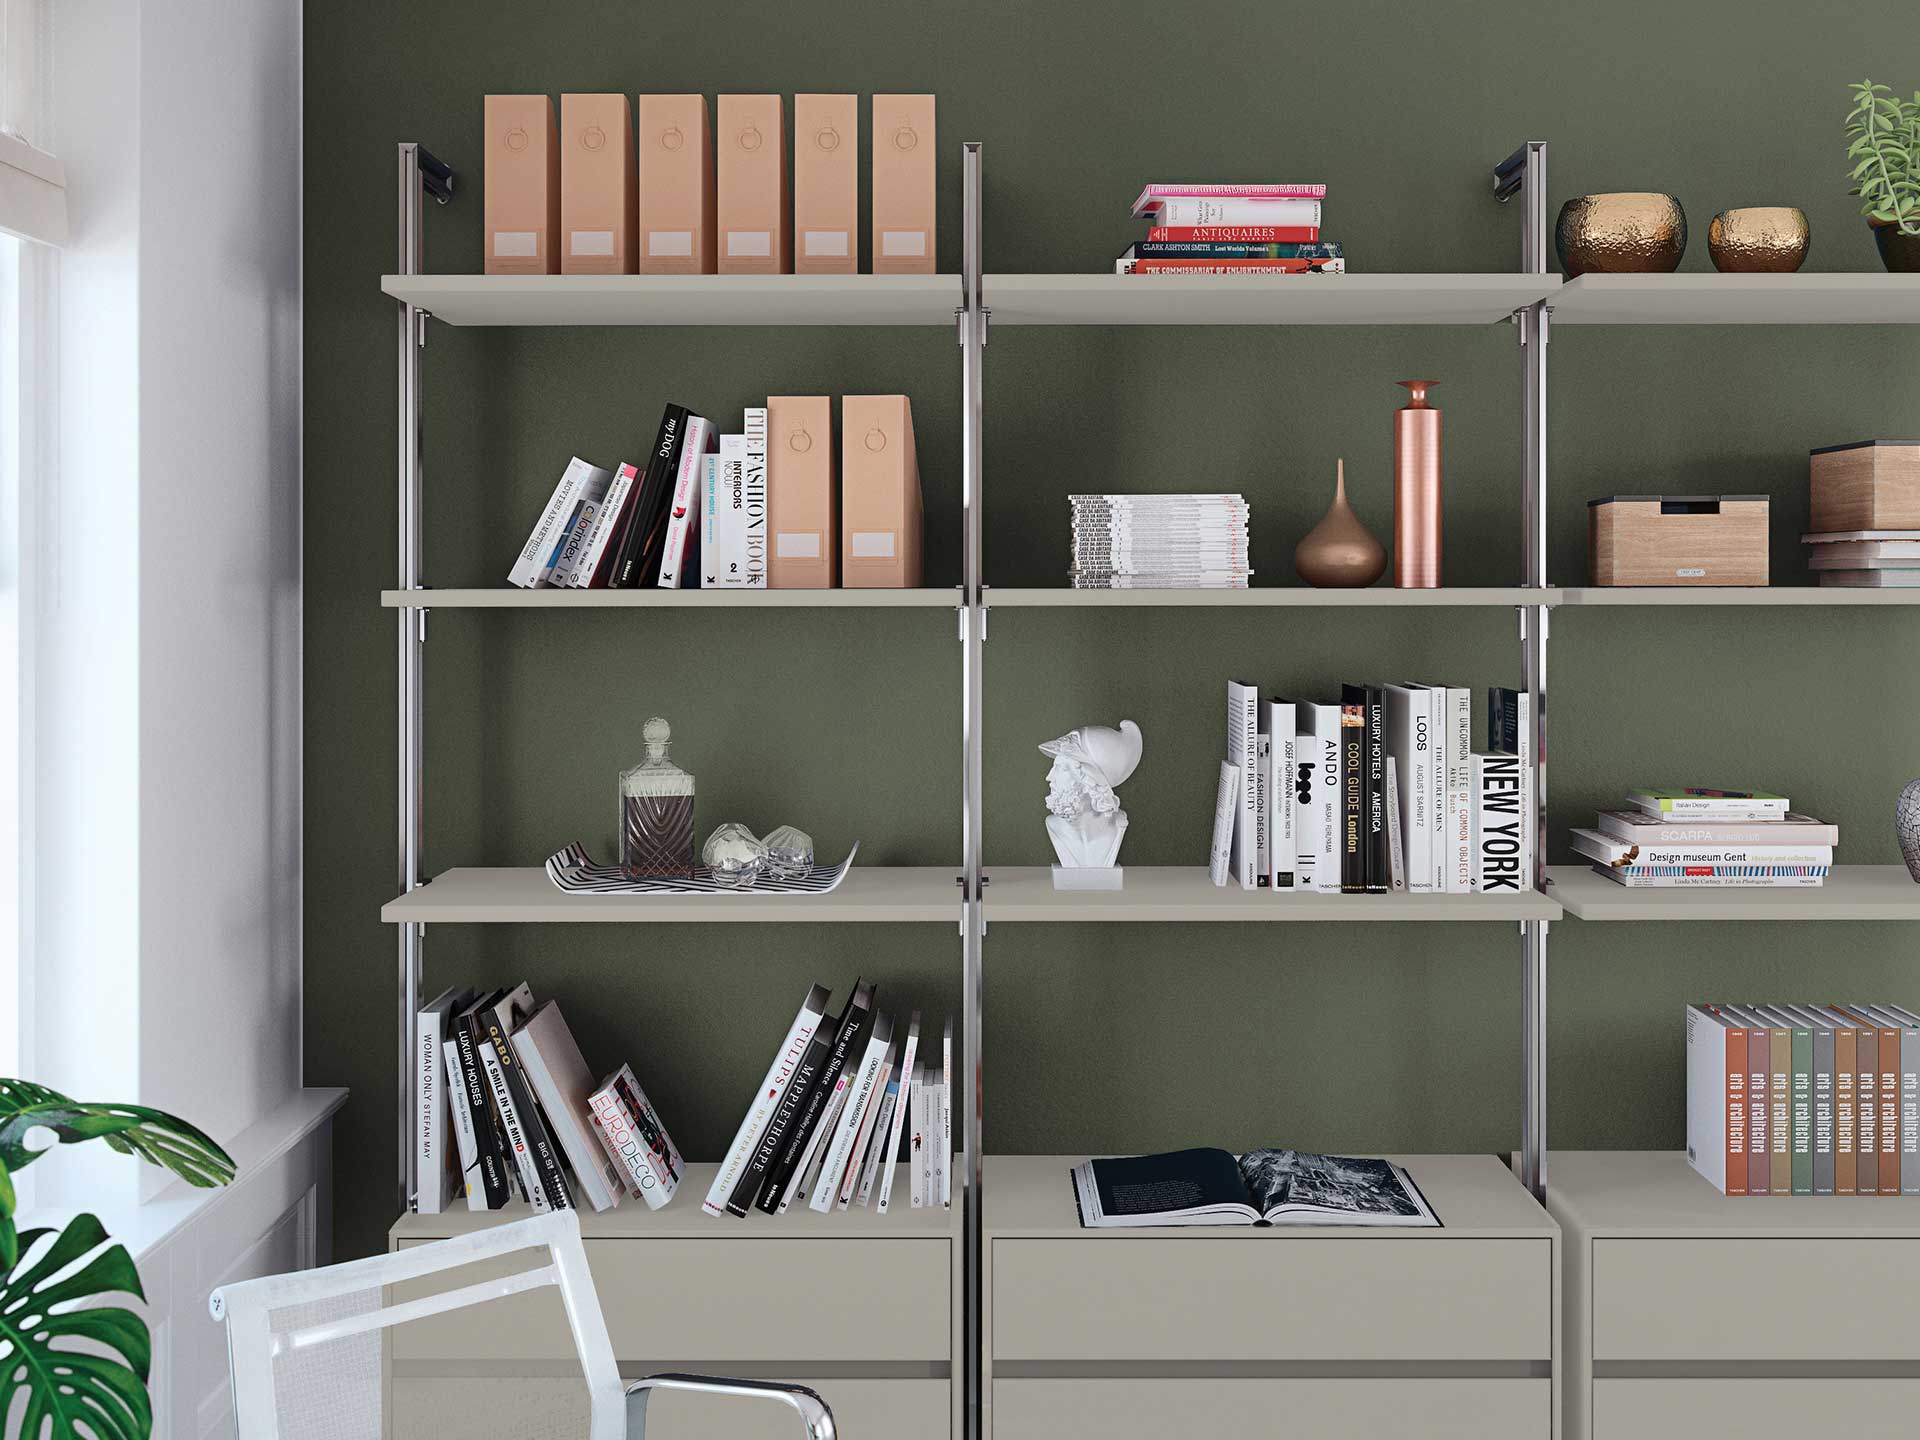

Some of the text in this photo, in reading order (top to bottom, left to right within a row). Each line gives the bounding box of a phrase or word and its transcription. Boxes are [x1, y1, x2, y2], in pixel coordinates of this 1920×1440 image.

[1142, 243, 1210, 251] CLARK ASHTON SMITH
[1192, 228, 1275, 239] ANTIQUAIRES
[1226, 266, 1286, 274] ENLIGHTENMENT
[658, 417, 676, 458] my DOG
[687, 424, 698, 446] History
[677, 479, 688, 501] Design
[724, 460, 732, 486] NOW!
[733, 460, 741, 508] INTERIORS
[553, 478, 573, 510] MOVIES
[746, 410, 764, 584] THE FASHION BOOK
[525, 525, 548, 561] METHODS
[562, 504, 598, 563] colorindex
[730, 563, 737, 573] 2
[1416, 715, 1427, 751] LOOS
[1246, 699, 1254, 810] THE ALLURE OF BEAUTY
[1284, 740, 1292, 798] JOSEF HOFFMANN
[1324, 740, 1336, 786] ANDO
[1371, 704, 1380, 832] LUXURY HOTELS AMERICA
[1347, 742, 1358, 852] COOL GUIDE London
[1416, 764, 1424, 826] AUGUST SARNITZ
[1434, 745, 1442, 832] THE ALLURE OF MEN
[1458, 696, 1468, 884] THE UNCOMMON LIFE OF COMMON OBJECTS
[1256, 773, 1264, 850] FASHION DESIGN
[1482, 758, 1520, 891] NEW YORK
[1660, 830, 1713, 841] SCARPA
[1649, 852, 1747, 864] Design museum Gent
[489, 1026, 511, 1067] GABO
[834, 1041, 848, 1057] and
[842, 1019, 859, 1042] Time
[423, 1034, 432, 1071] WOMAN
[458, 1029, 473, 1066] LUXURY
[466, 1067, 482, 1106] HOUSES
[486, 1058, 496, 1066] A
[773, 1021, 813, 1085] TULIPS
[821, 1056, 842, 1086] Silence
[423, 1075, 432, 1100] ONLY
[488, 1066, 505, 1096] SMILE
[498, 1095, 509, 1107] IN
[808, 1089, 823, 1112] Caroline
[847, 1056, 879, 1128] LOOKING FOR TRANSMISSION
[503, 1107, 516, 1126] THE
[751, 1062, 814, 1172] MAPPLETHORPE
[755, 1107, 766, 1119] BY
[1730, 1073, 1745, 1153] arts architecture
[1752, 1073, 1767, 1153] arts architecture
[1774, 1073, 1788, 1153] arts architecture
[1796, 1073, 1810, 1153] arts architecture
[1817, 1073, 1832, 1153] arts architecture
[1839, 1073, 1854, 1153] arts architecture
[1861, 1073, 1876, 1153] arts architecture
[1882, 1073, 1898, 1153] arts architecture
[1904, 1073, 1919, 1153] arts architecture
[509, 1126, 525, 1152] MIND
[537, 1141, 549, 1158] BIG
[594, 1094, 656, 1190] EURODECO
[740, 1121, 759, 1149] PETER
[718, 1152, 743, 1192] ARNOLD
